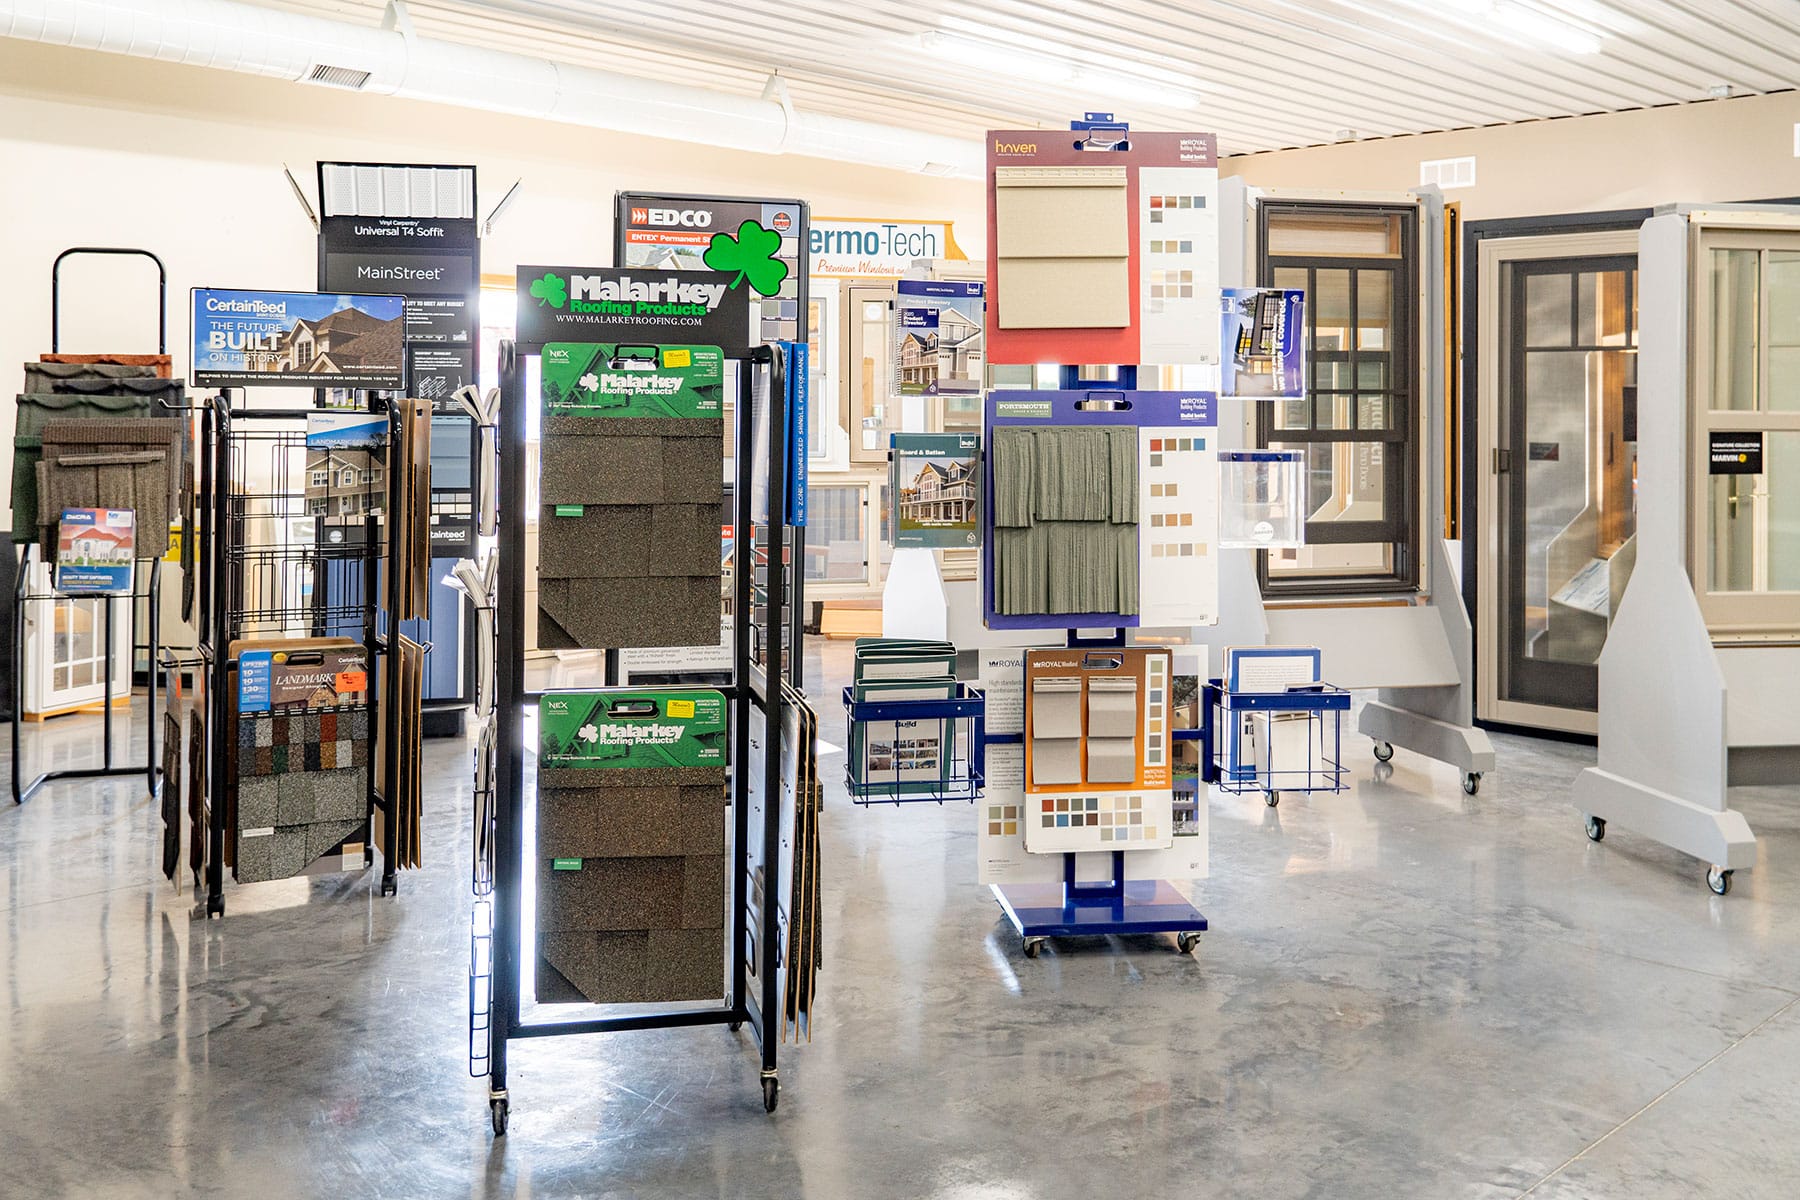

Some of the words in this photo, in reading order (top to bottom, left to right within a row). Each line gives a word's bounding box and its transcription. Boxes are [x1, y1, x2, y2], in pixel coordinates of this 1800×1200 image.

[648, 208, 712, 228] EDCO
[354, 226, 399, 236] Universal
[402, 227, 414, 236] T4
[416, 228, 444, 237] Soffit
[660, 234, 703, 243] Permanent
[809, 224, 936, 257] ermo-Tech
[817, 258, 856, 273] Premium
[858, 260, 894, 274] Windows
[570, 274, 727, 309] Malarkey
[206, 298, 286, 314] CertainTeed
[570, 300, 632, 316] Roofing
[210, 321, 233, 331] THE
[236, 322, 283, 332] FUTURE
[556, 314, 702, 326] WWW.MALARKEYROOFING.COM
[1278, 298, 1286, 340] covered.
[209, 331, 283, 351] BUILT
[209, 353, 228, 362] ON
[232, 353, 283, 363] HISTORY
[1276, 351, 1284, 375] have
[601, 374, 684, 391] Malarkey
[1278, 376, 1285, 391] we
[600, 387, 634, 395] Roofing
[430, 530, 465, 539] tainteed
[275, 672, 334, 685] LANDMARK
[600, 724, 685, 739] Malarkey
[600, 738, 634, 746] Roofing
